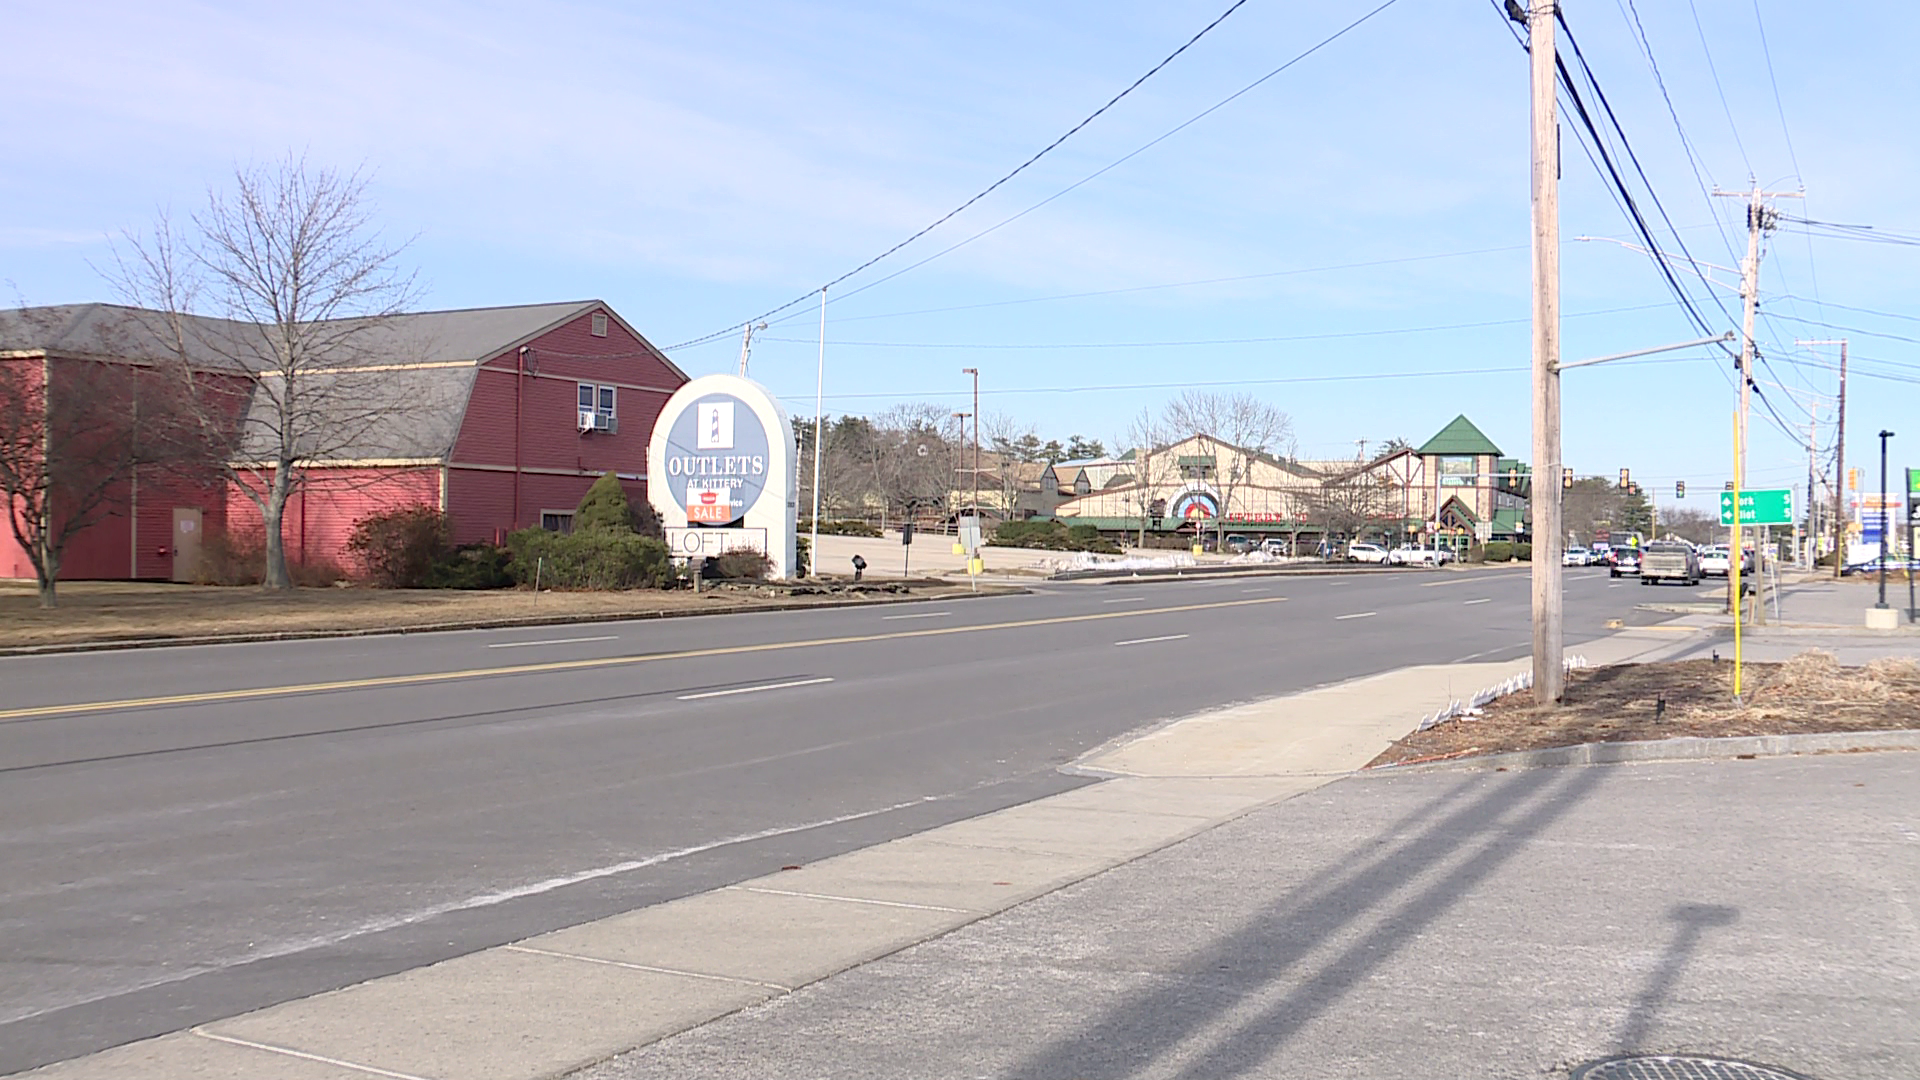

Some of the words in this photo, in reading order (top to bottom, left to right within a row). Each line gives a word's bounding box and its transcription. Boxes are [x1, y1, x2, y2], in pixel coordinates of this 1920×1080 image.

[668, 455, 764, 476] OUTLETS
[687, 479, 699, 489] AT
[702, 478, 744, 489] KITTERY
[693, 506, 723, 519] SALE
[671, 532, 729, 554] LOFT
